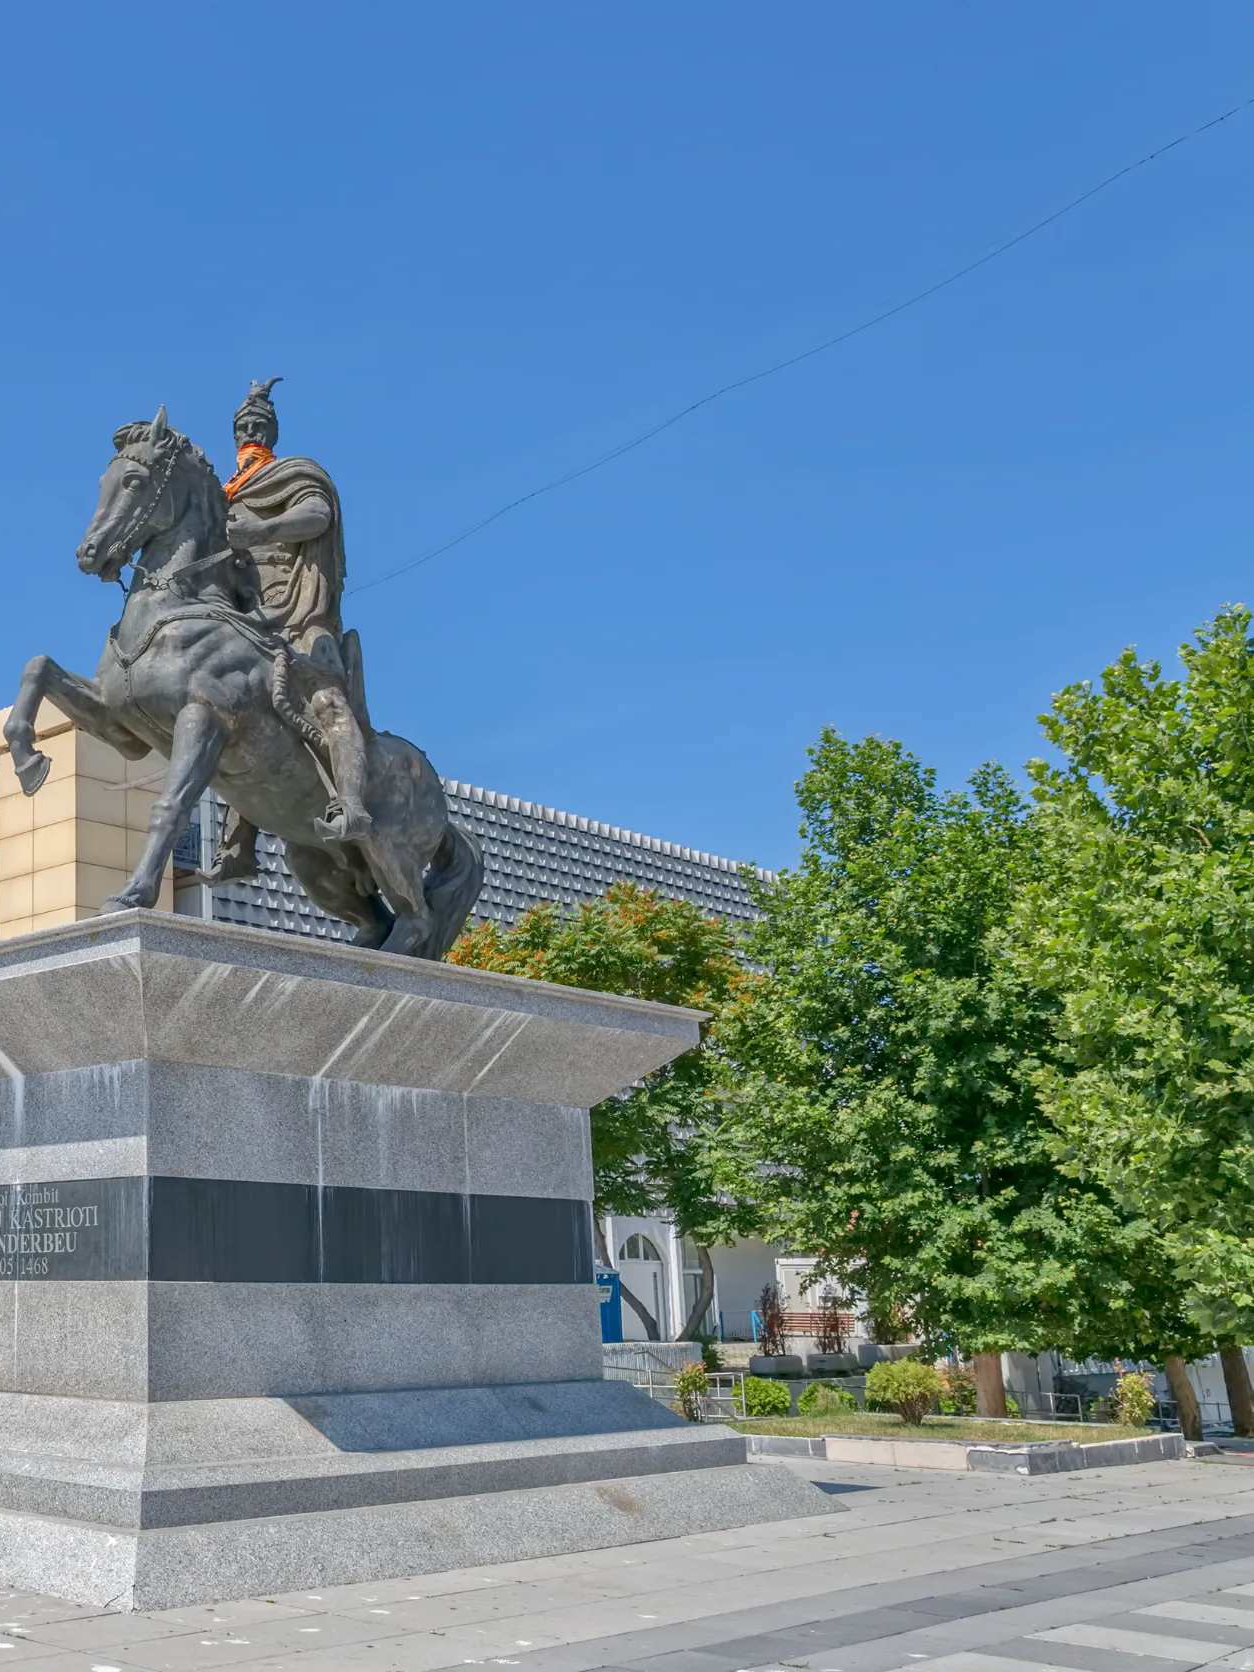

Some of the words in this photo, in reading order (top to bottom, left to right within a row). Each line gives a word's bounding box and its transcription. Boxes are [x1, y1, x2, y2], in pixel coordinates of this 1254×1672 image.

[16, 1187, 59, 1205] Kombit
[10, 1206, 98, 1229] KASTRIOTI
[20, 1257, 48, 1275] 1468
